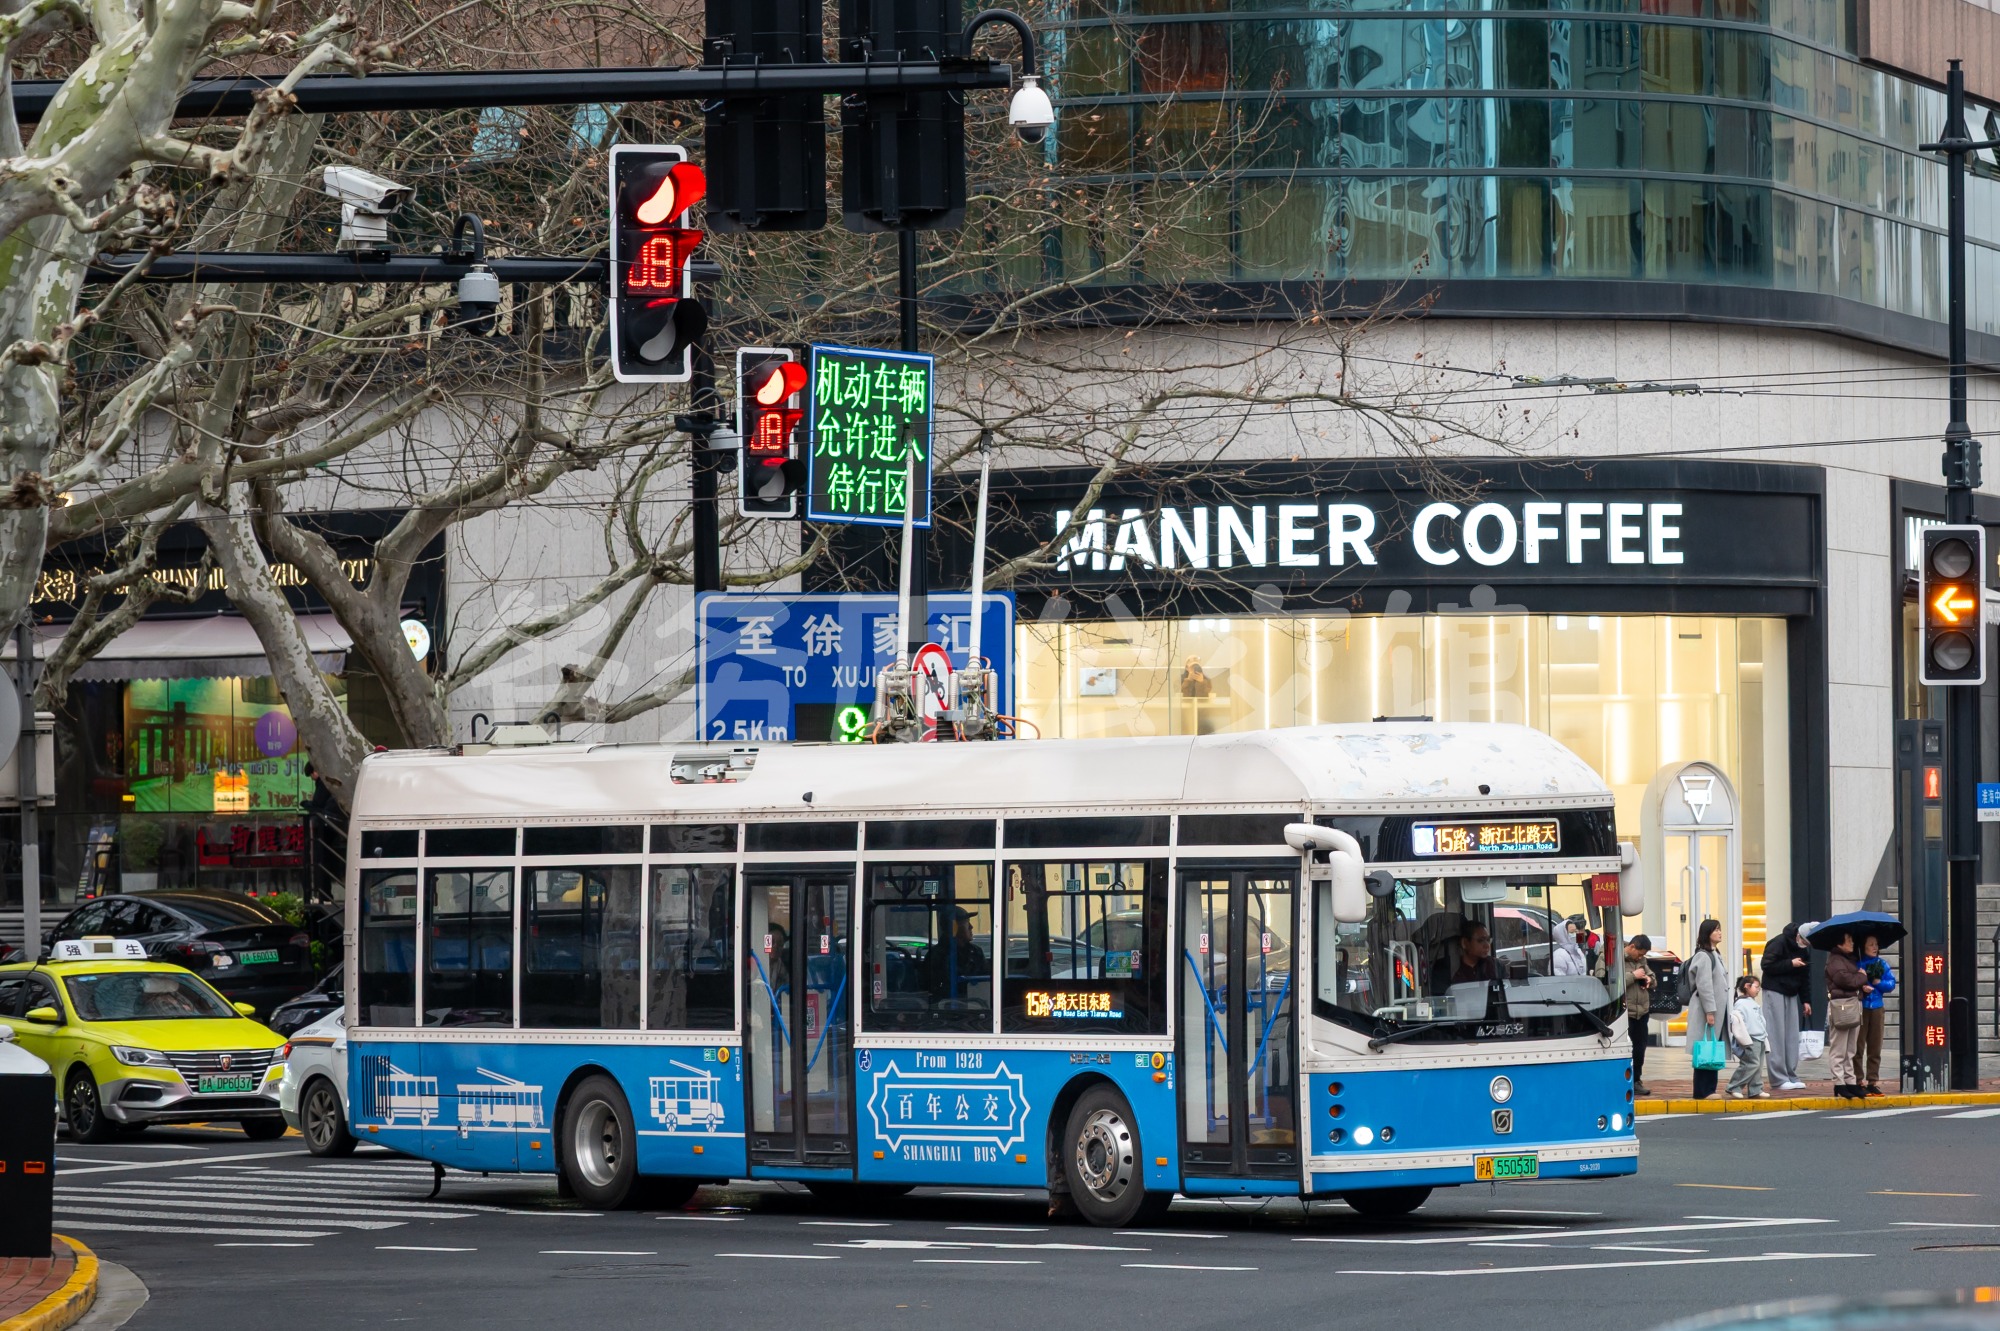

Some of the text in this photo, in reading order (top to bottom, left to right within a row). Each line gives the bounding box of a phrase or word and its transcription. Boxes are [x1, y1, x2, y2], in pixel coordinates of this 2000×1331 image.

[815, 356, 926, 414] 机动车辆
[815, 408, 925, 461] 允许进入
[827, 462, 908, 513] 待行区
[1055, 502, 1684, 571] MANNER COFFEE
[736, 614, 972, 656] 至徐家汇
[782, 666, 876, 687] TO XUJI
[1434, 825, 1556, 851] 15路 浙江北路天
[65, 944, 141, 956] 强生
[1925, 955, 1943, 974] 遵守
[1026, 992, 1049, 1017] 15路
[1926, 991, 1944, 1009] 交通
[1926, 1026, 1945, 1046] 信号
[916, 1052, 983, 1069] From 1928
[217, 1077, 252, 1089] DP6037
[898, 1093, 999, 1121] 百年公交
[903, 1145, 997, 1162] SHANGHAI BUS
[1497, 1158, 1536, 1175] 55053D
